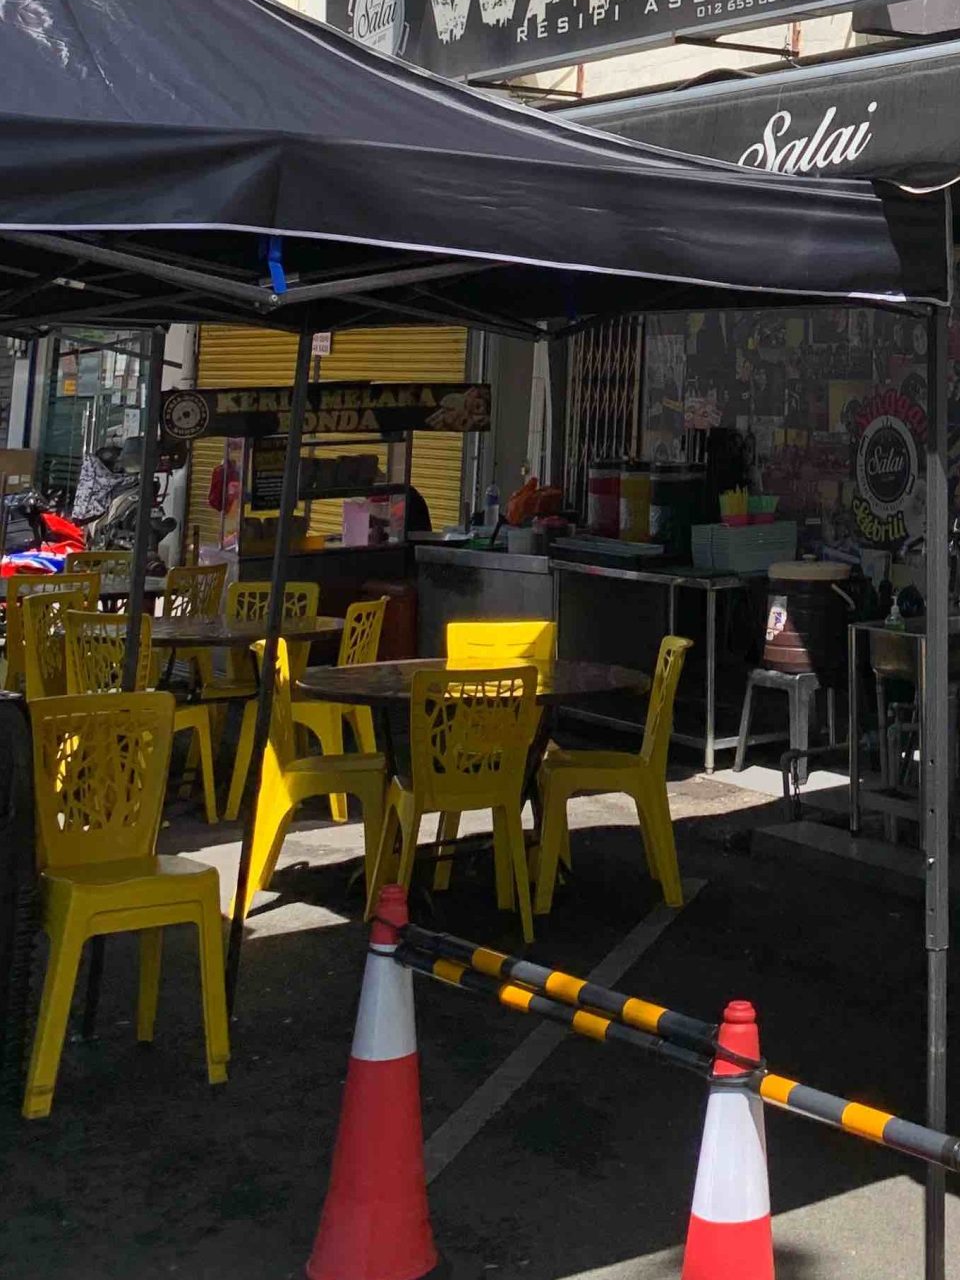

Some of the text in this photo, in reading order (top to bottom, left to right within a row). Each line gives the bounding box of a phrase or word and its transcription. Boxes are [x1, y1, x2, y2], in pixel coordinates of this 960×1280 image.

[516, 4, 619, 43] RESIPI
[697, 1, 723, 19] 012
[737, 101, 878, 175] Salai
